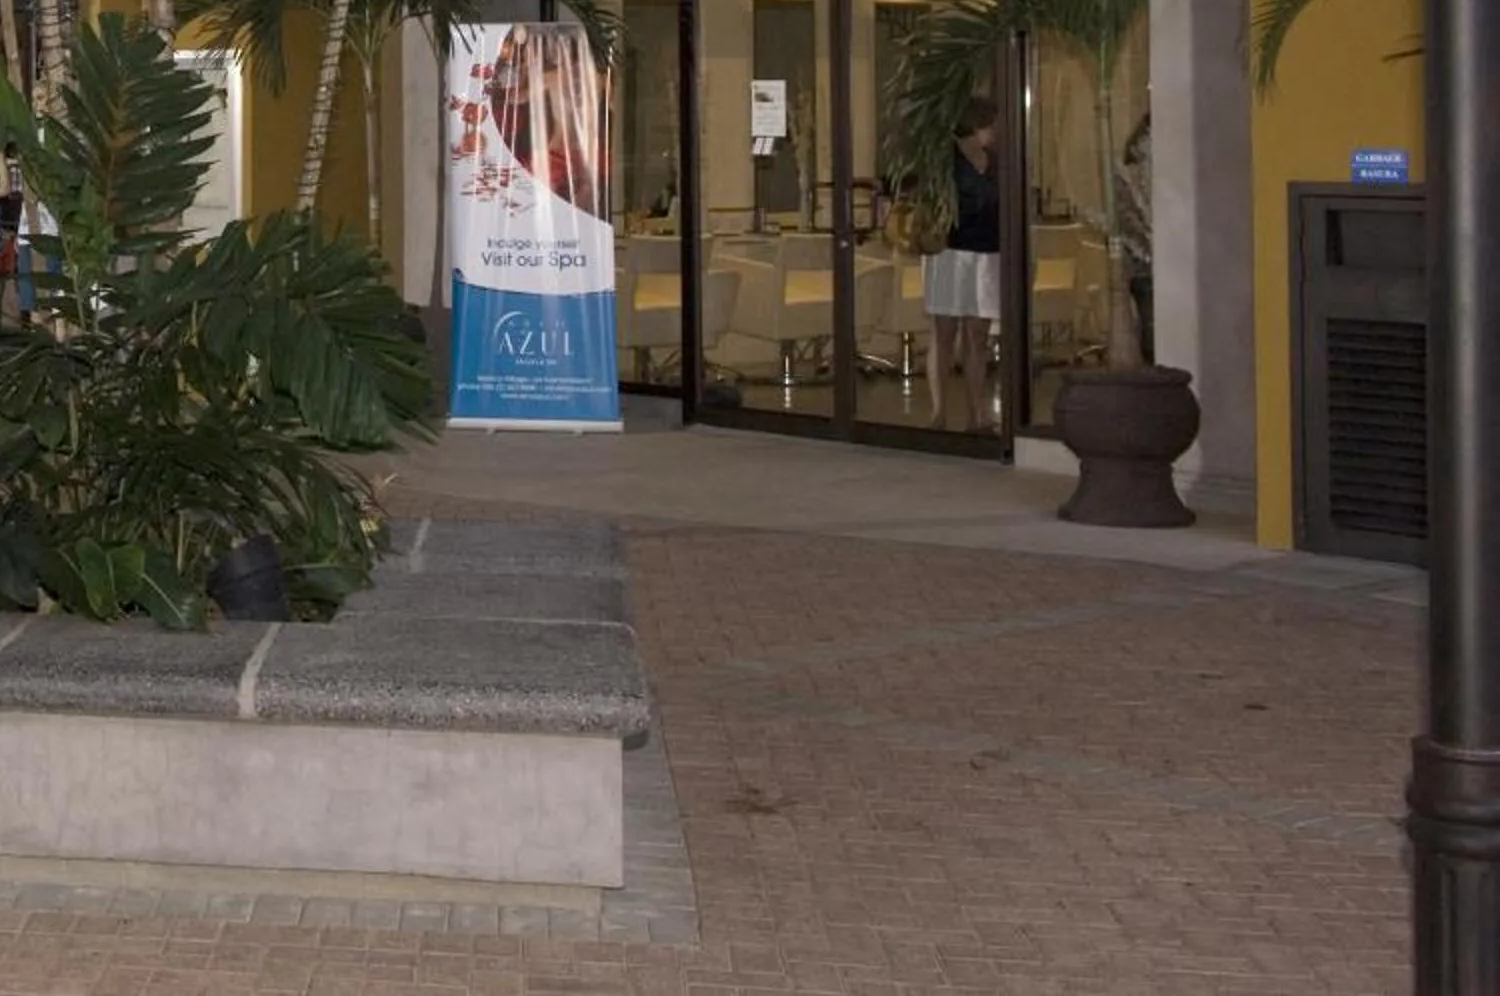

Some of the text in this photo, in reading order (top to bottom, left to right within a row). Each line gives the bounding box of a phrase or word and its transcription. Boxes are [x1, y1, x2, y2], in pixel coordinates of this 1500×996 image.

[481, 251, 587, 272] Visit our Spa
[500, 331, 575, 357] AZUL
